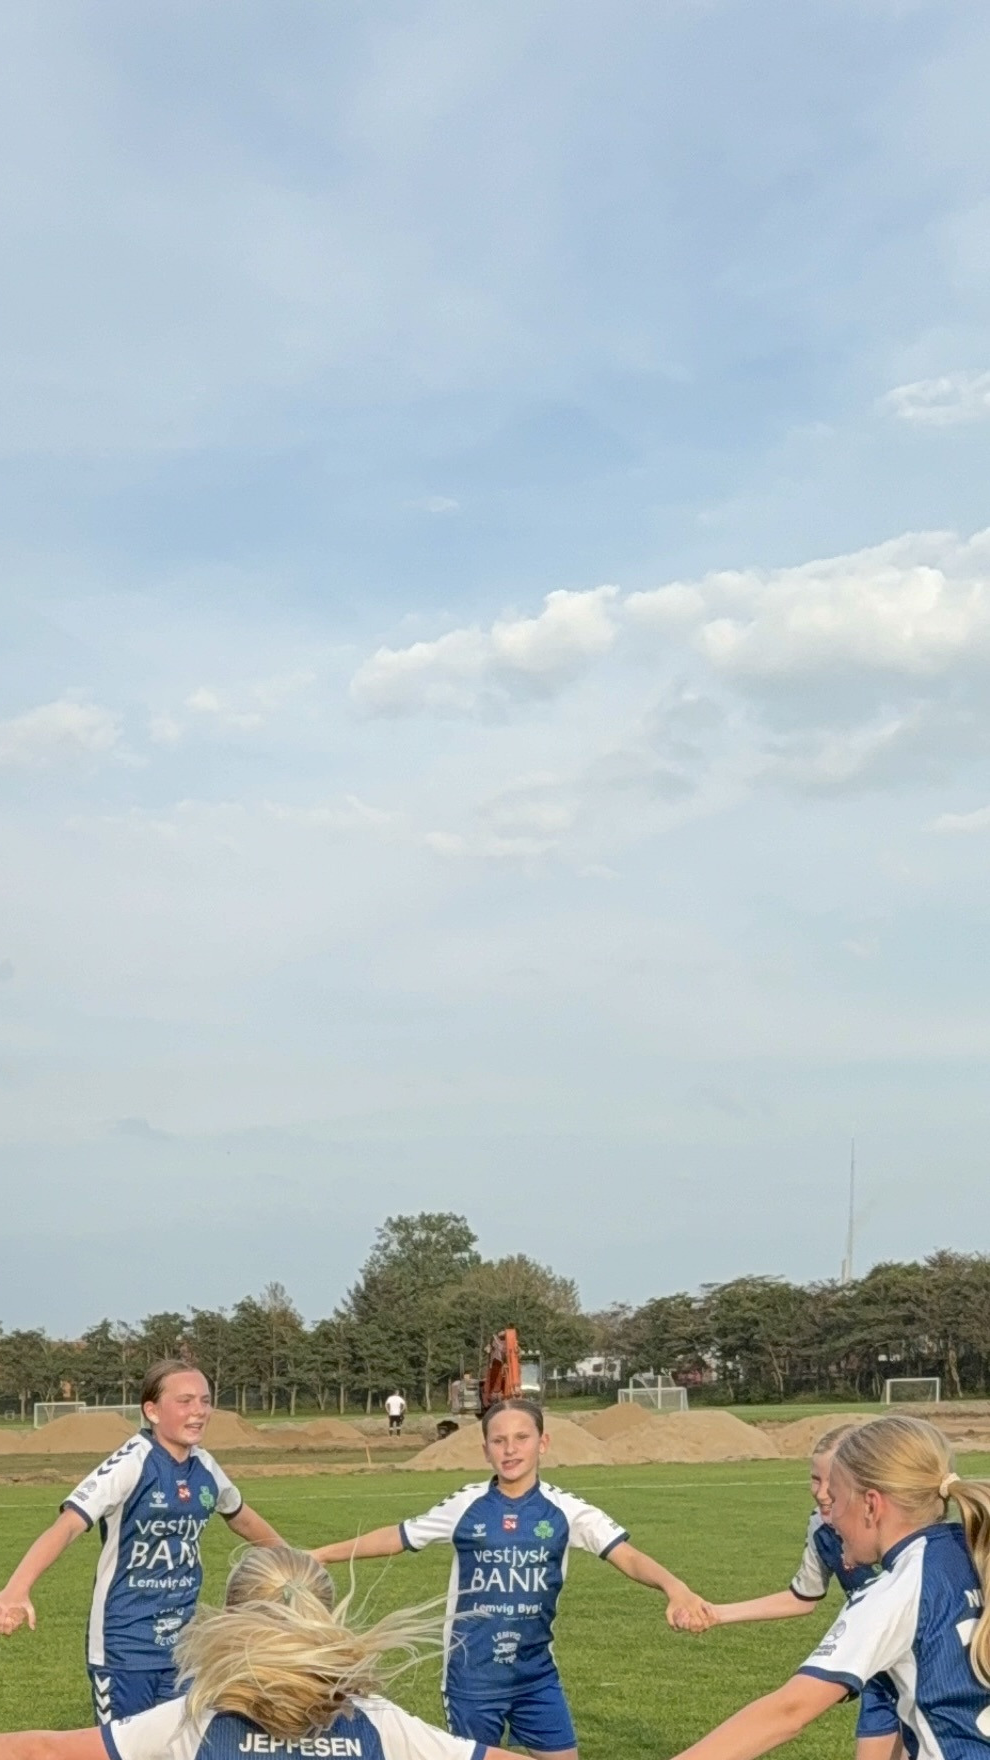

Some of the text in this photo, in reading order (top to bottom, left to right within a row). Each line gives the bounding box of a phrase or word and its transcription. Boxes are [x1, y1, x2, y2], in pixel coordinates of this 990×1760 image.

[126, 1539, 202, 1570] BAN
[473, 1545, 550, 1567] vestjysk
[471, 1567, 549, 1593] BANK
[473, 1602, 514, 1616] Lemvig
